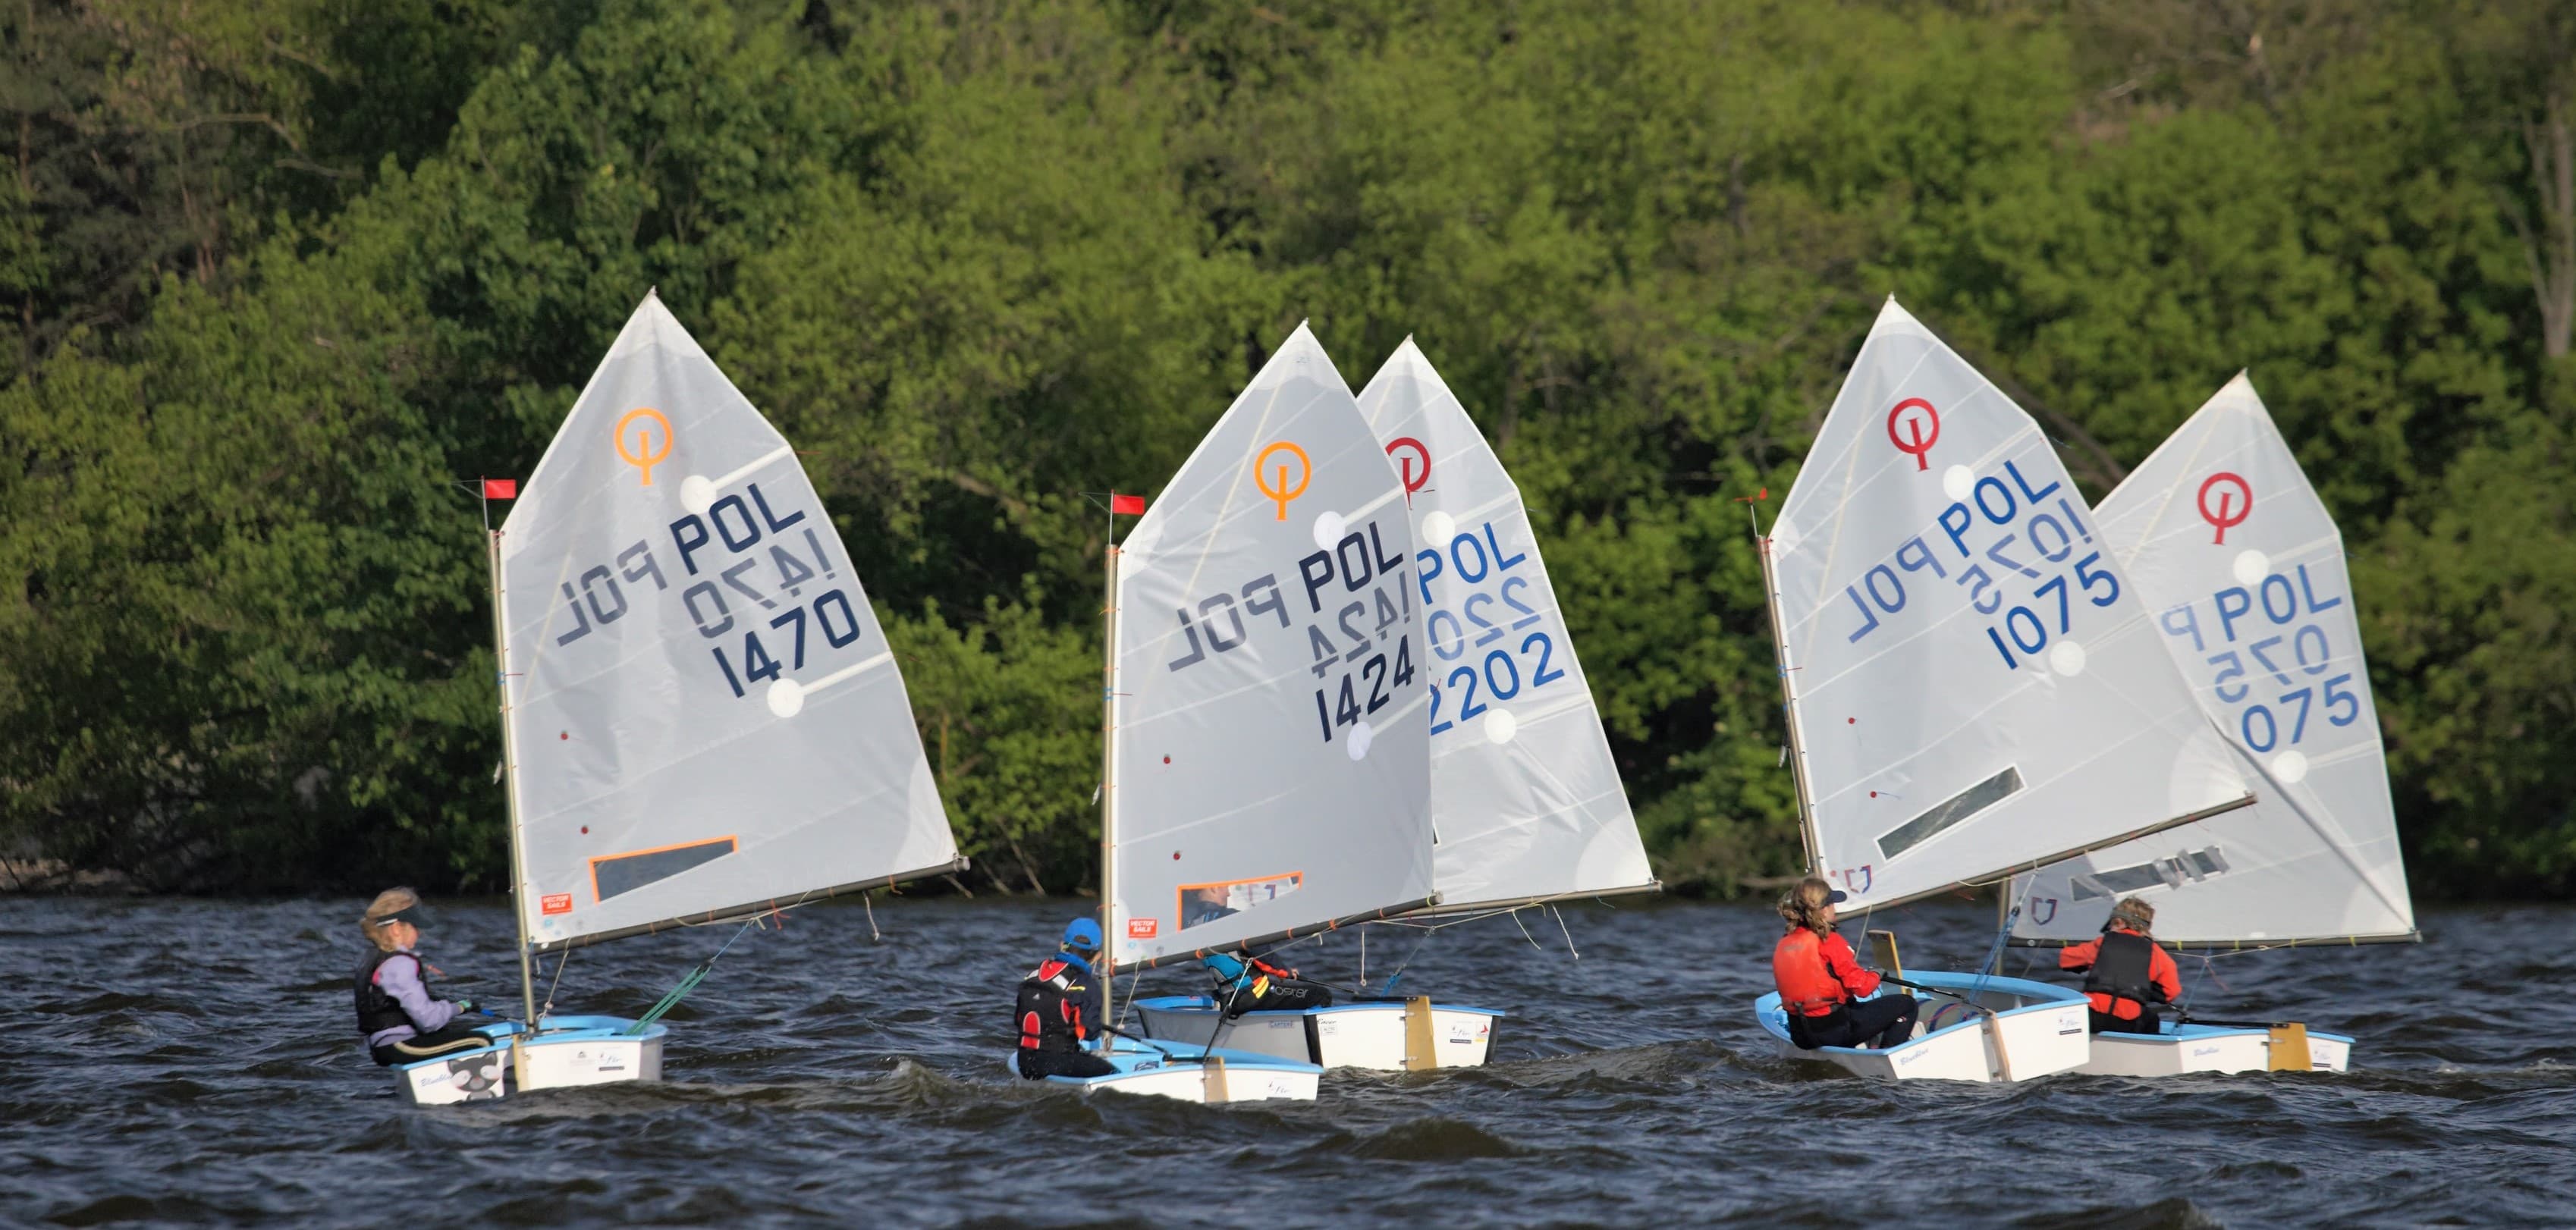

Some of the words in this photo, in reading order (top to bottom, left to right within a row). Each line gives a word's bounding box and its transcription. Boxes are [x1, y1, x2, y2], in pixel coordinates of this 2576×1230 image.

[669, 483, 806, 576] POL
[1937, 460, 2060, 557] POL
[1299, 520, 1403, 613] POL
[1416, 522, 1526, 605] POL
[2214, 563, 2342, 642] POL
[712, 588, 860, 698] 1470
[1987, 551, 2120, 670] 1075
[1315, 635, 1415, 742] 1424
[2242, 673, 2359, 752] 075
[1270, 985, 1309, 998] oster
